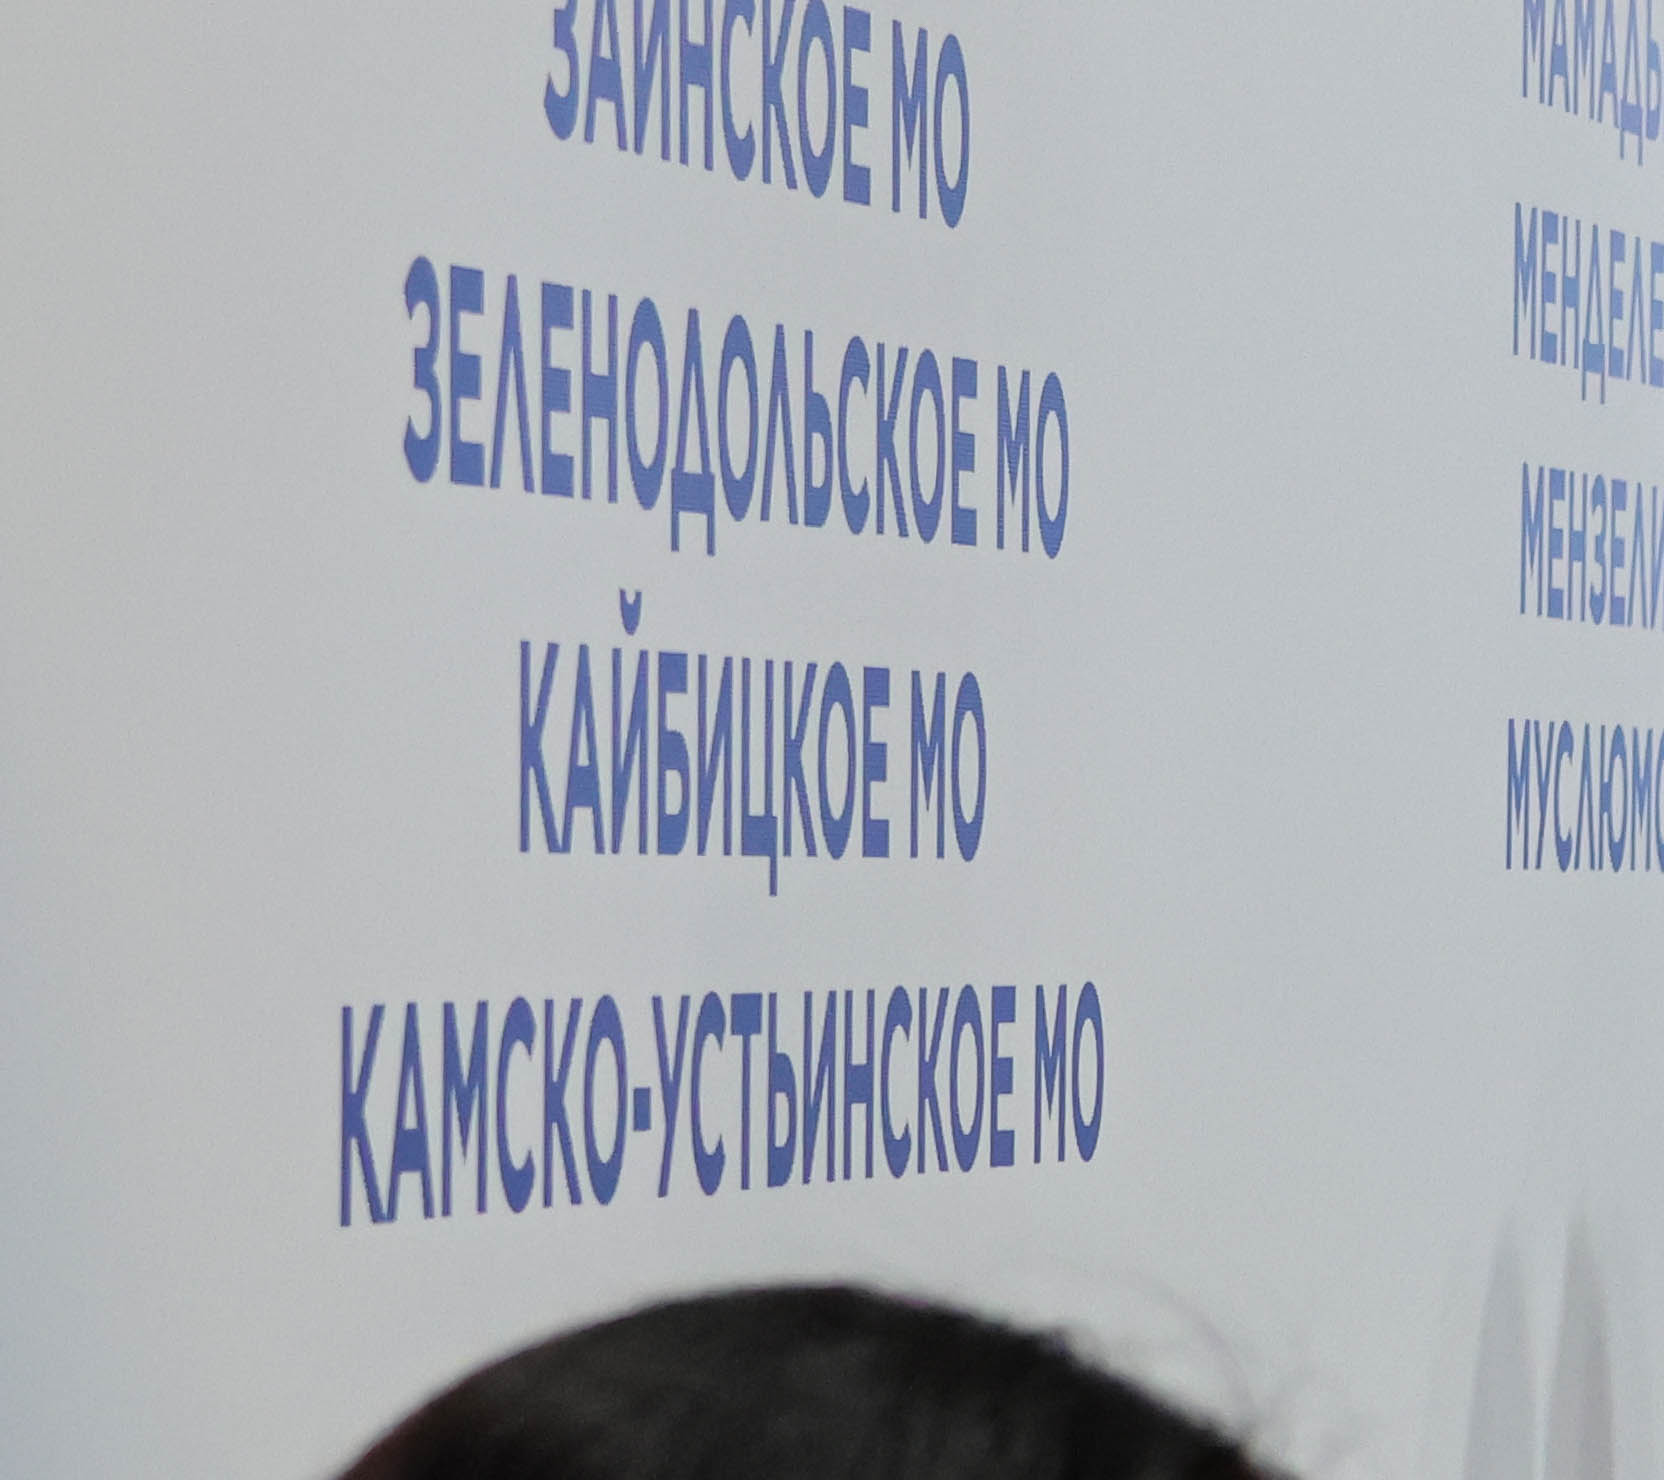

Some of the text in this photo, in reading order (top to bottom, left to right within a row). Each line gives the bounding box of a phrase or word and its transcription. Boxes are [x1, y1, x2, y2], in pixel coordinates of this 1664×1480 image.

[544, 0, 970, 229] ЗАИНСКОЕ МО
[402, 255, 1070, 560] ЗЕЛЕНОДОЛЬСКОЕ МО
[519, 588, 987, 896] КАЙБИЦКОЕ МО
[339, 980, 1105, 1227] КАМСКО-УСТЬИНСКОЕ МО
